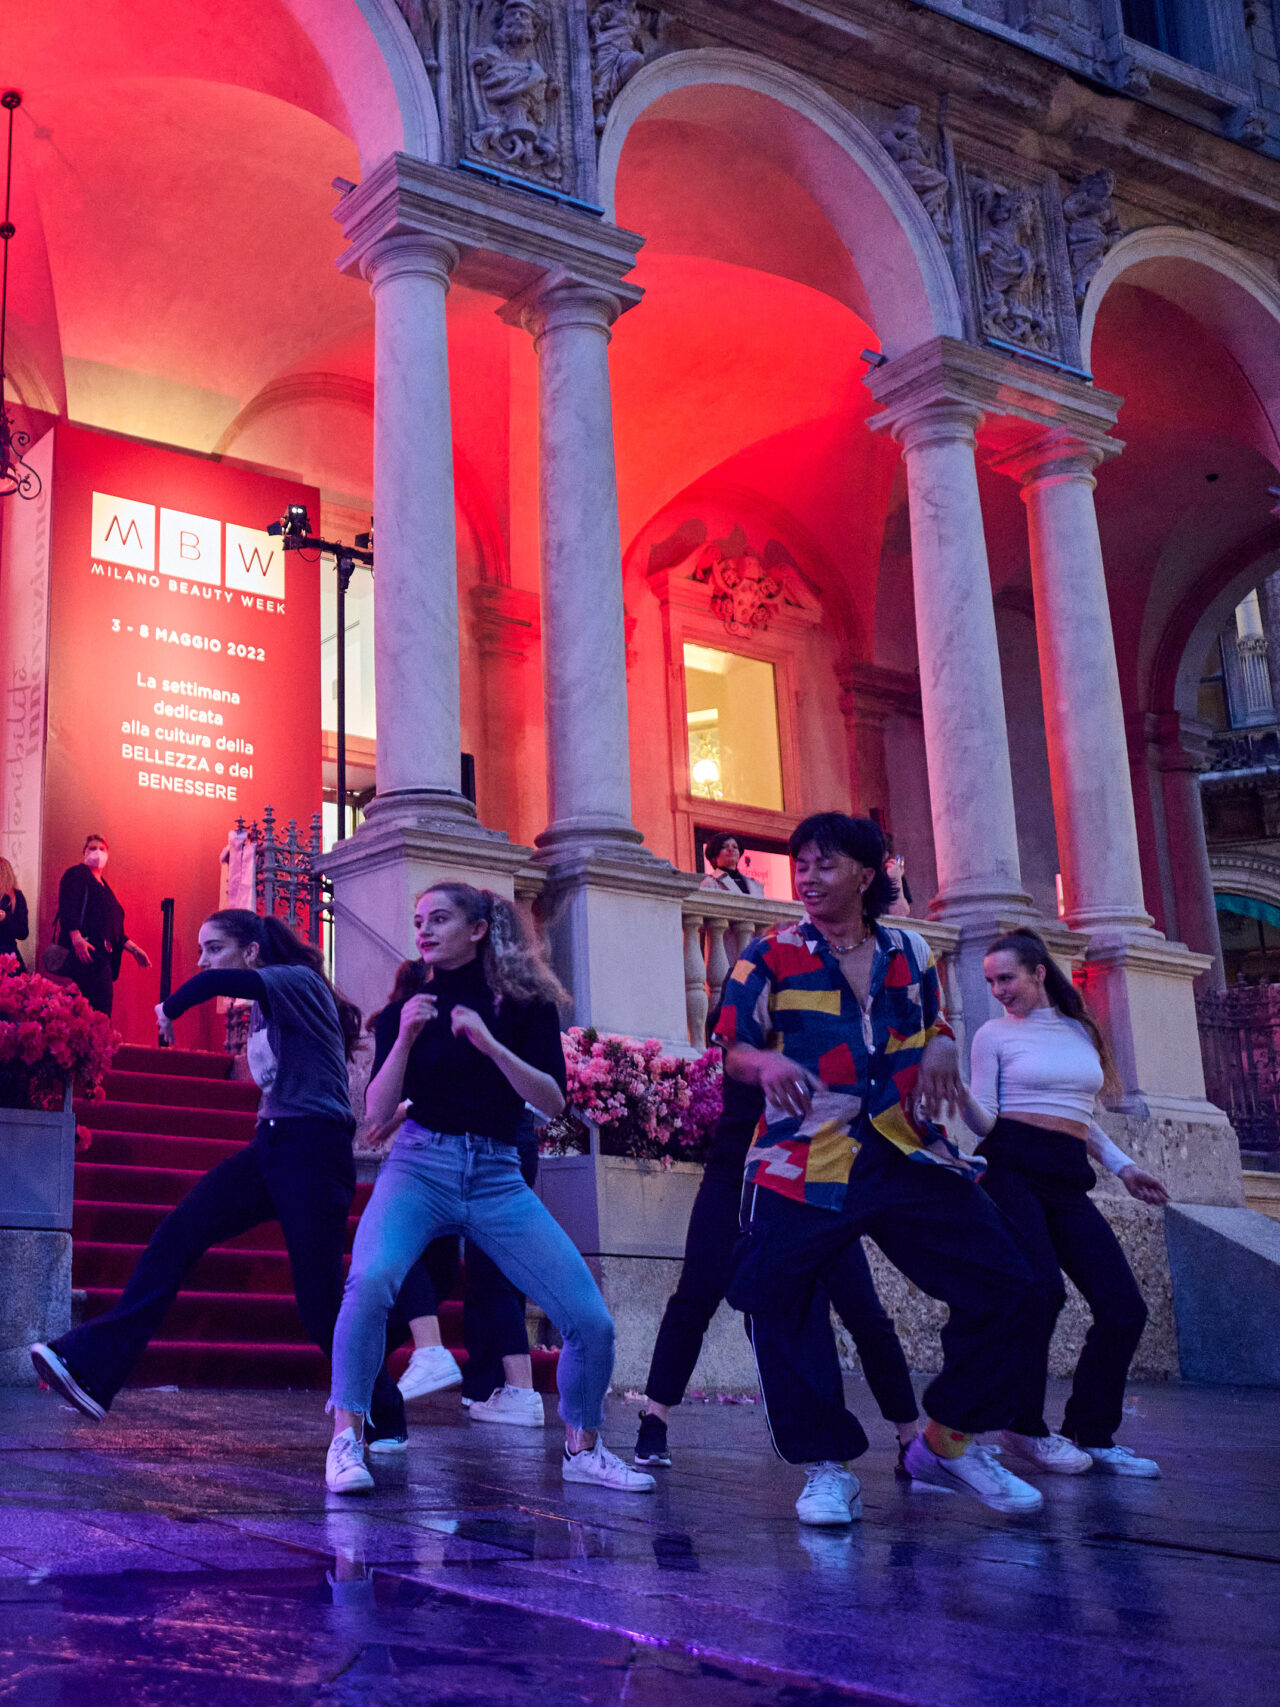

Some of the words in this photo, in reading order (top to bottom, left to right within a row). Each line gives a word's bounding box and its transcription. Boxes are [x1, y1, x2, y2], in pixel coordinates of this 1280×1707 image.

[91, 563, 160, 587] MILANO
[169, 580, 234, 603] BEAUTY
[241, 595, 286, 614] WEEK
[111, 619, 120, 632] 3
[140, 624, 149, 638] 8
[155, 628, 221, 652] MAGGIO
[227, 642, 266, 661] 2022
[137, 672, 156, 689] La
[162, 679, 240, 704] settimana
[153, 700, 223, 725] dedicata
[121, 719, 149, 737] alla
[155, 727, 211, 748] cultura
[215, 736, 254, 755] della
[122, 744, 210, 772] BELLEZZA
[214, 762, 224, 774] e
[229, 762, 253, 780] del
[138, 772, 237, 801] BENESSERE
